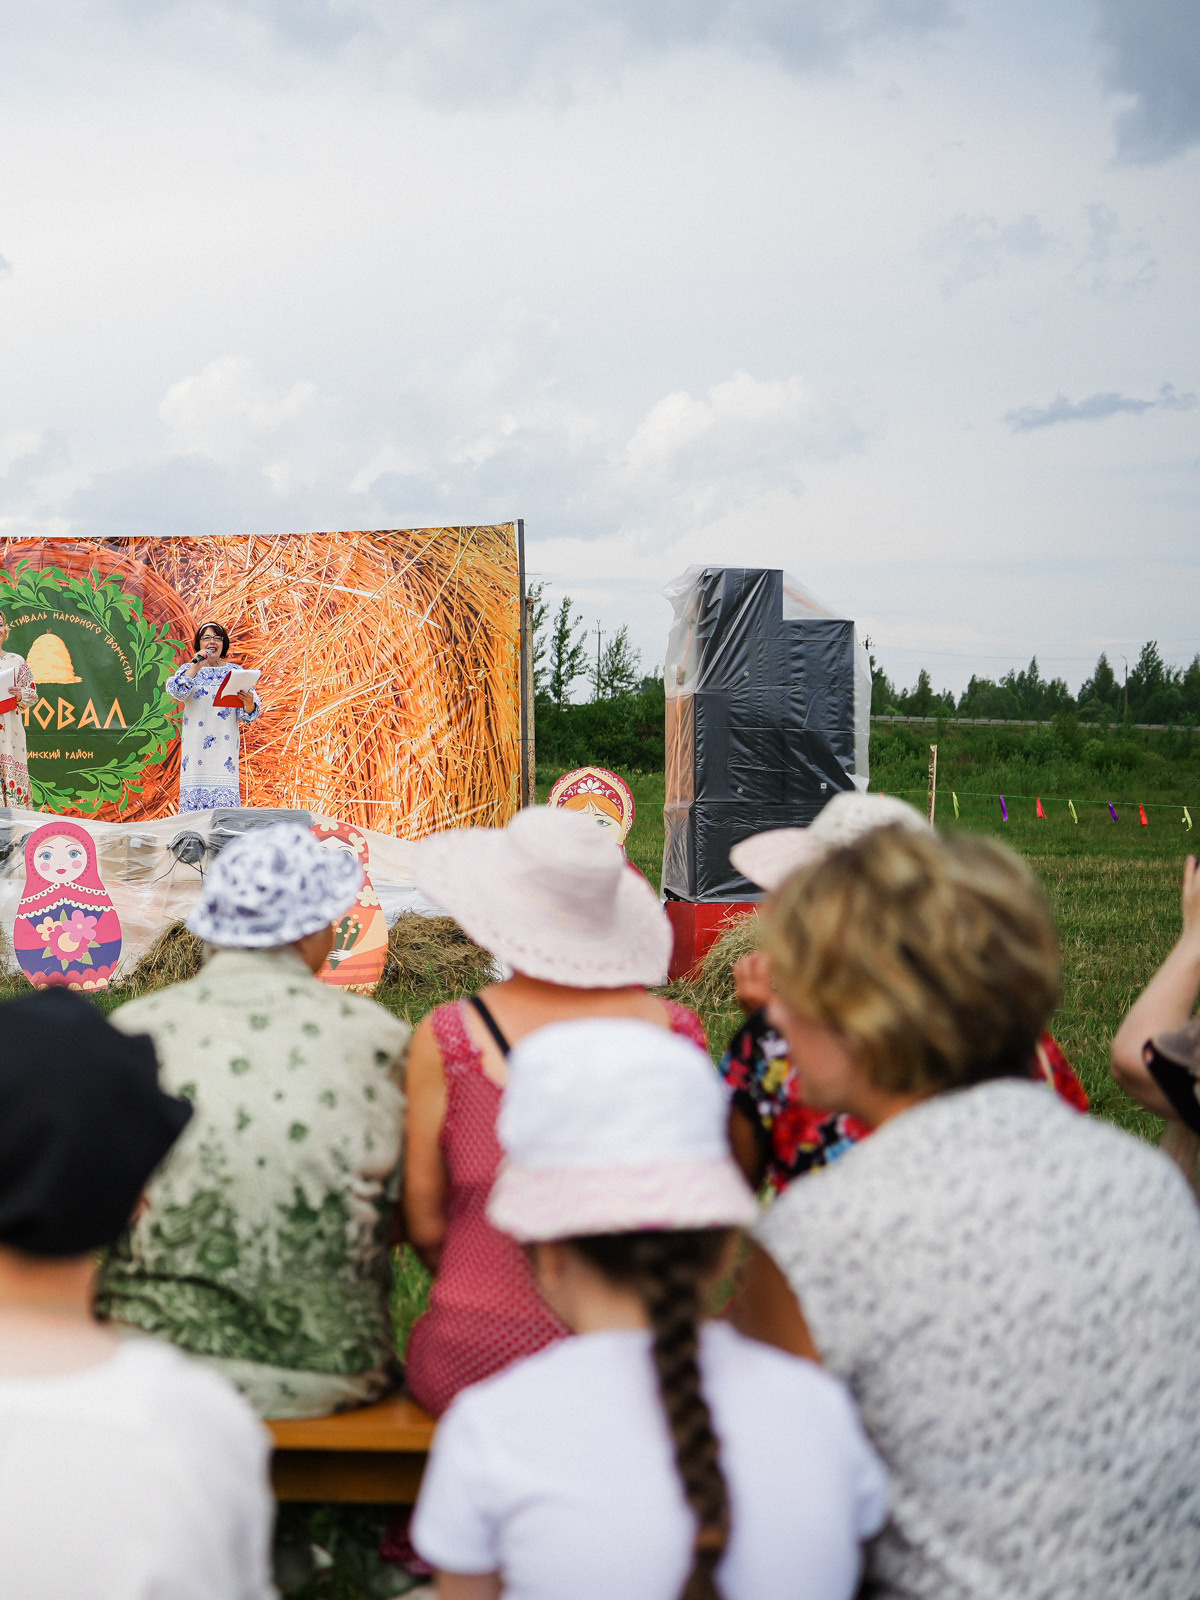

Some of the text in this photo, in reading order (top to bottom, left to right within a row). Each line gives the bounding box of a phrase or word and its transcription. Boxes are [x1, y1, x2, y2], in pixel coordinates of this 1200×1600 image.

[5, 611, 135, 683] ЕСТИВАЛЬ НАРОДНОГО ТВОРЧЕСТВА
[27, 748, 94, 760] ИНСКИЙ РАЙОН
